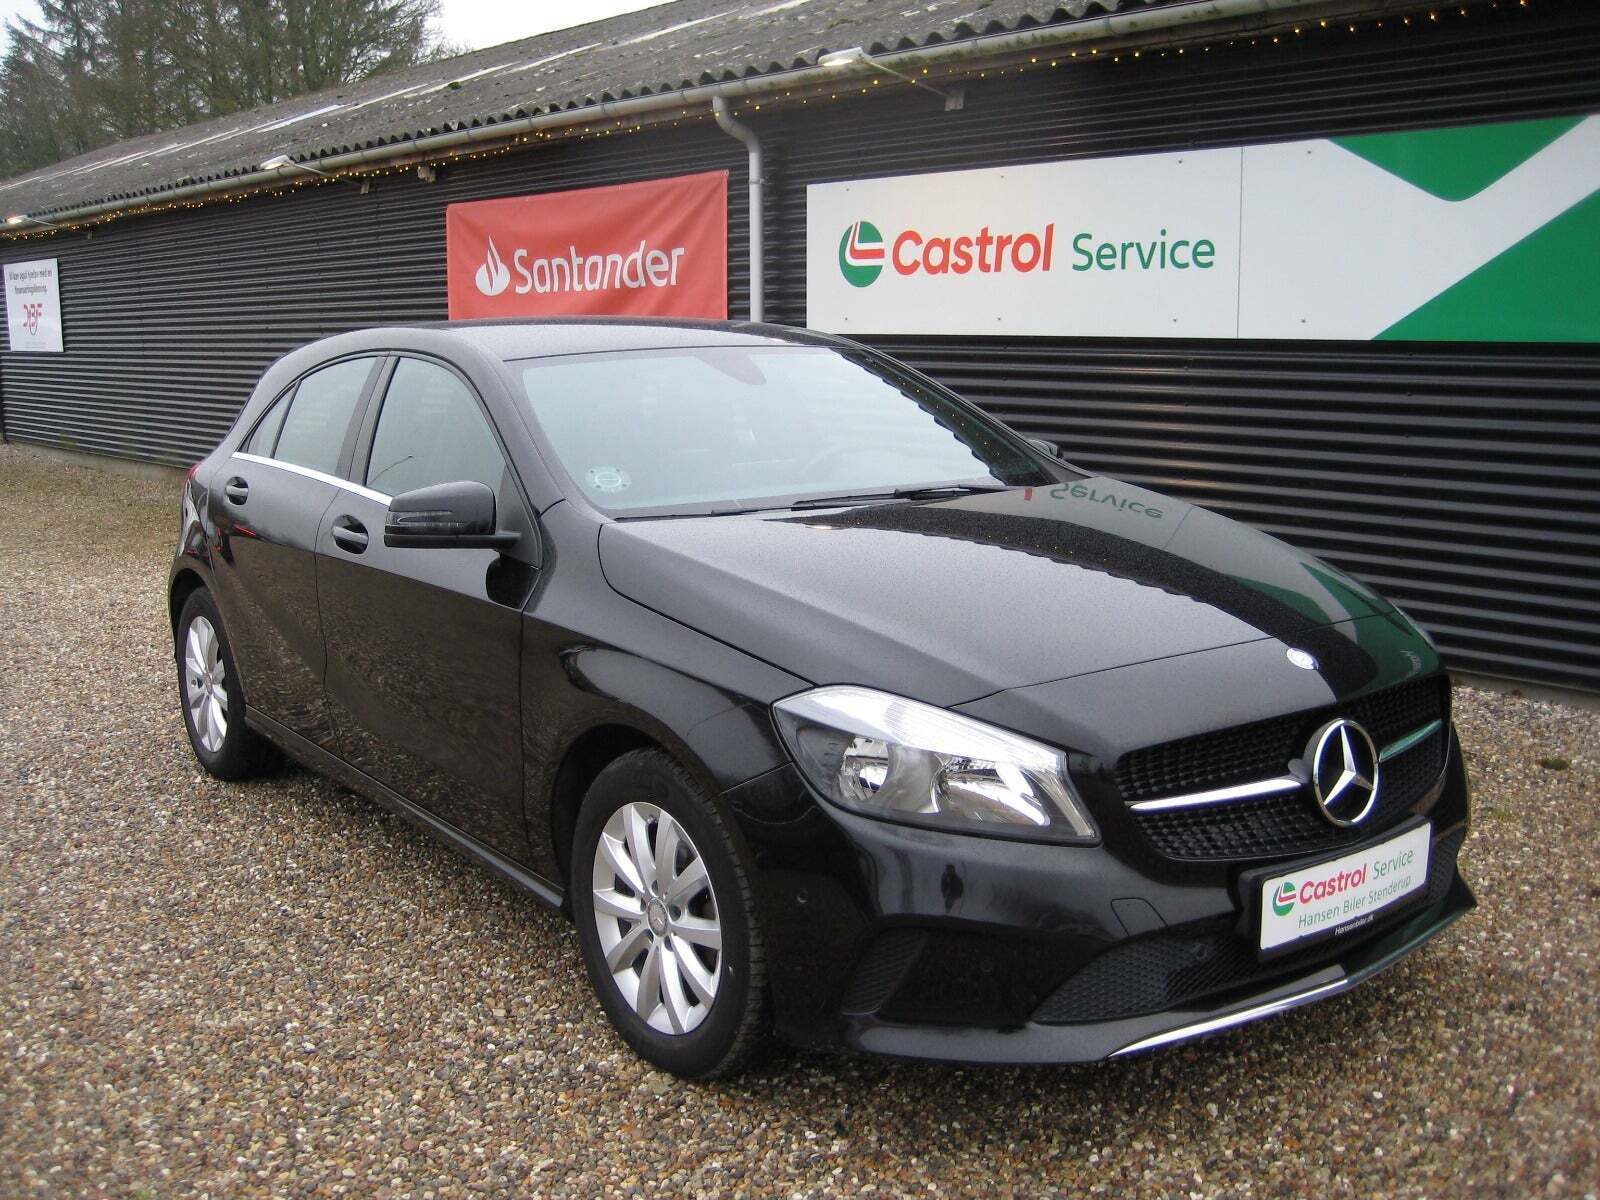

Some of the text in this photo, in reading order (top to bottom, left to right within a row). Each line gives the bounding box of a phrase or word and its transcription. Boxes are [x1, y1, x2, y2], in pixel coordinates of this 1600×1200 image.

[514, 239, 685, 293] Santander
[892, 222, 1216, 275] Castrol Service
[1298, 875, 1412, 928] Hansen Biler Stenderup
[1299, 848, 1414, 905] Castrol Service
